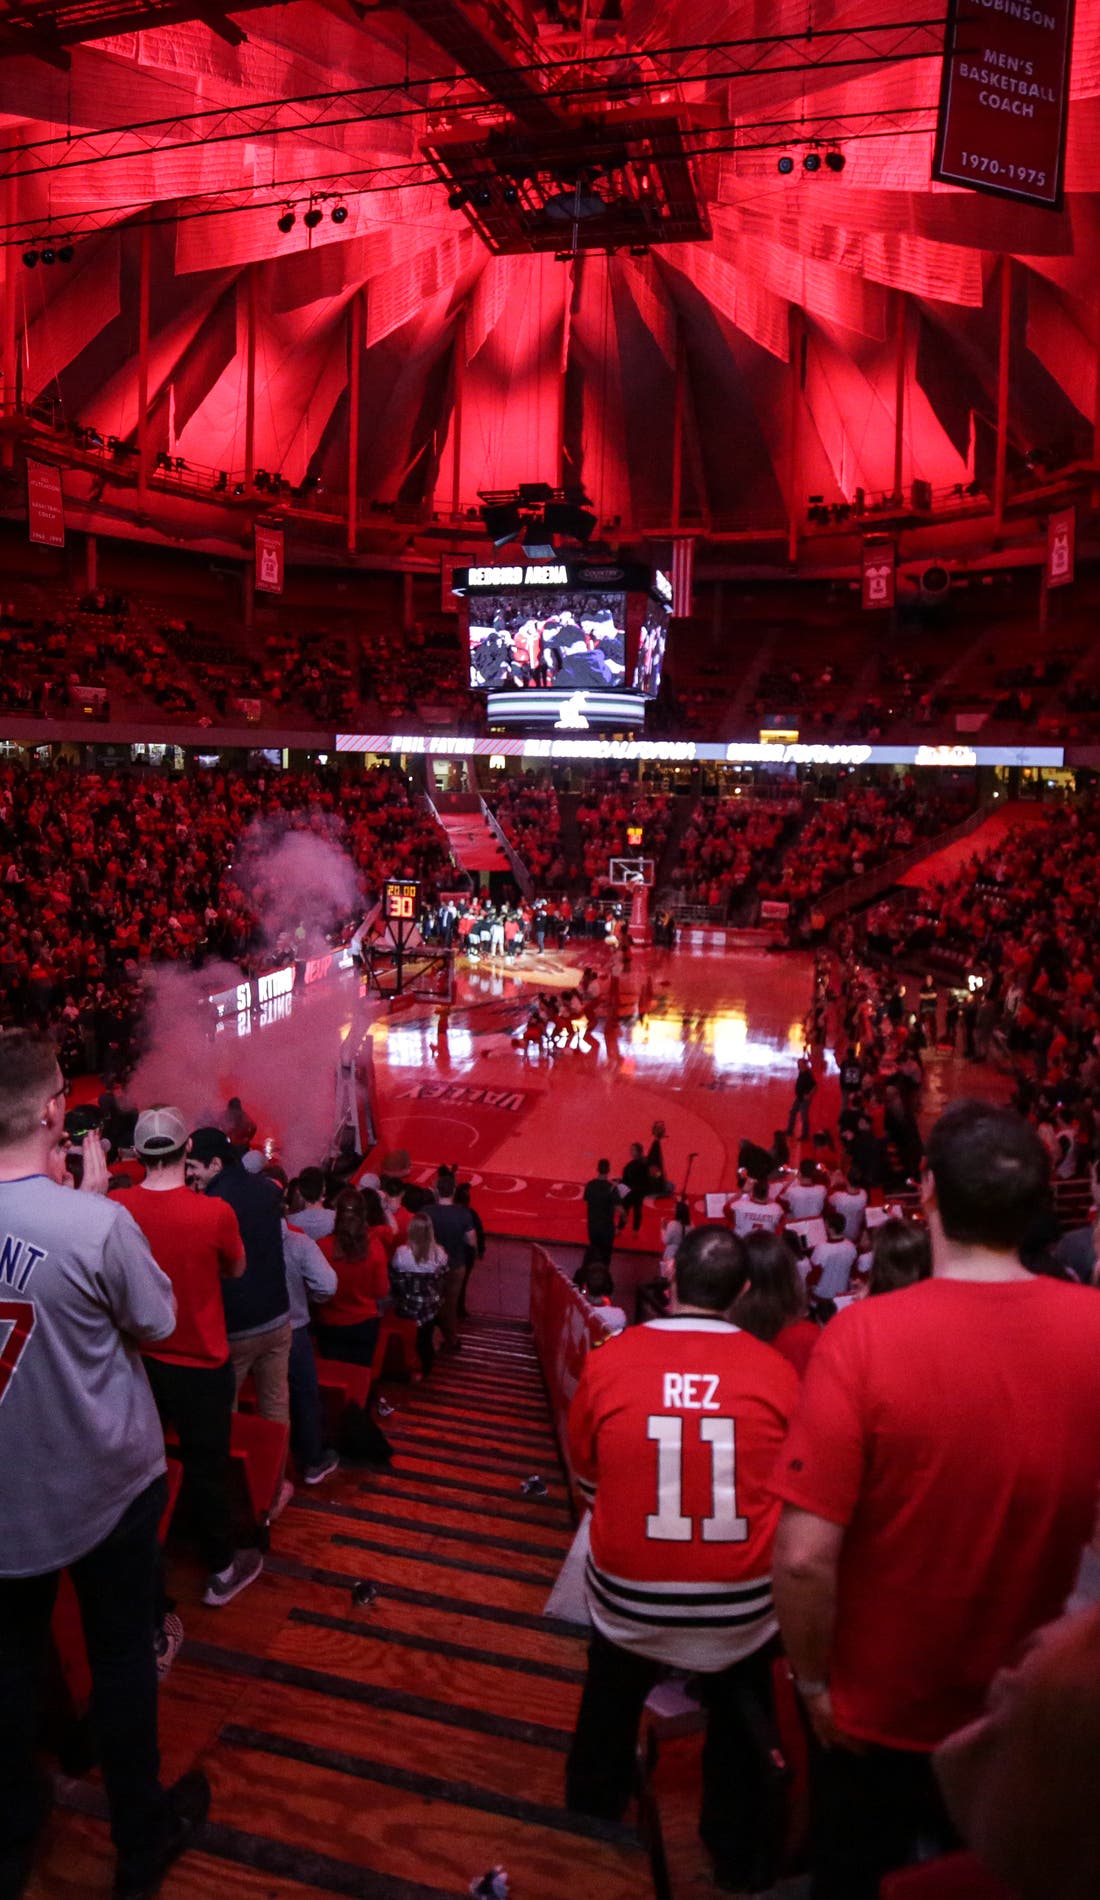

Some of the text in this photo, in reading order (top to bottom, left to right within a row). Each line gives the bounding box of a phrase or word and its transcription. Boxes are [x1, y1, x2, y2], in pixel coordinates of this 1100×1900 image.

[983, 48, 1034, 76] MEN'S
[959, 63, 1056, 103] BASKETBALL
[978, 91, 1034, 118] COACH
[960, 151, 1046, 187] 1970-1975
[524, 565, 568, 585] ARENA
[389, 896, 413, 918] 30
[395, 1080, 527, 1112] VALLEY
[663, 1372, 721, 1411] REZ
[645, 1414, 749, 1543] 11
